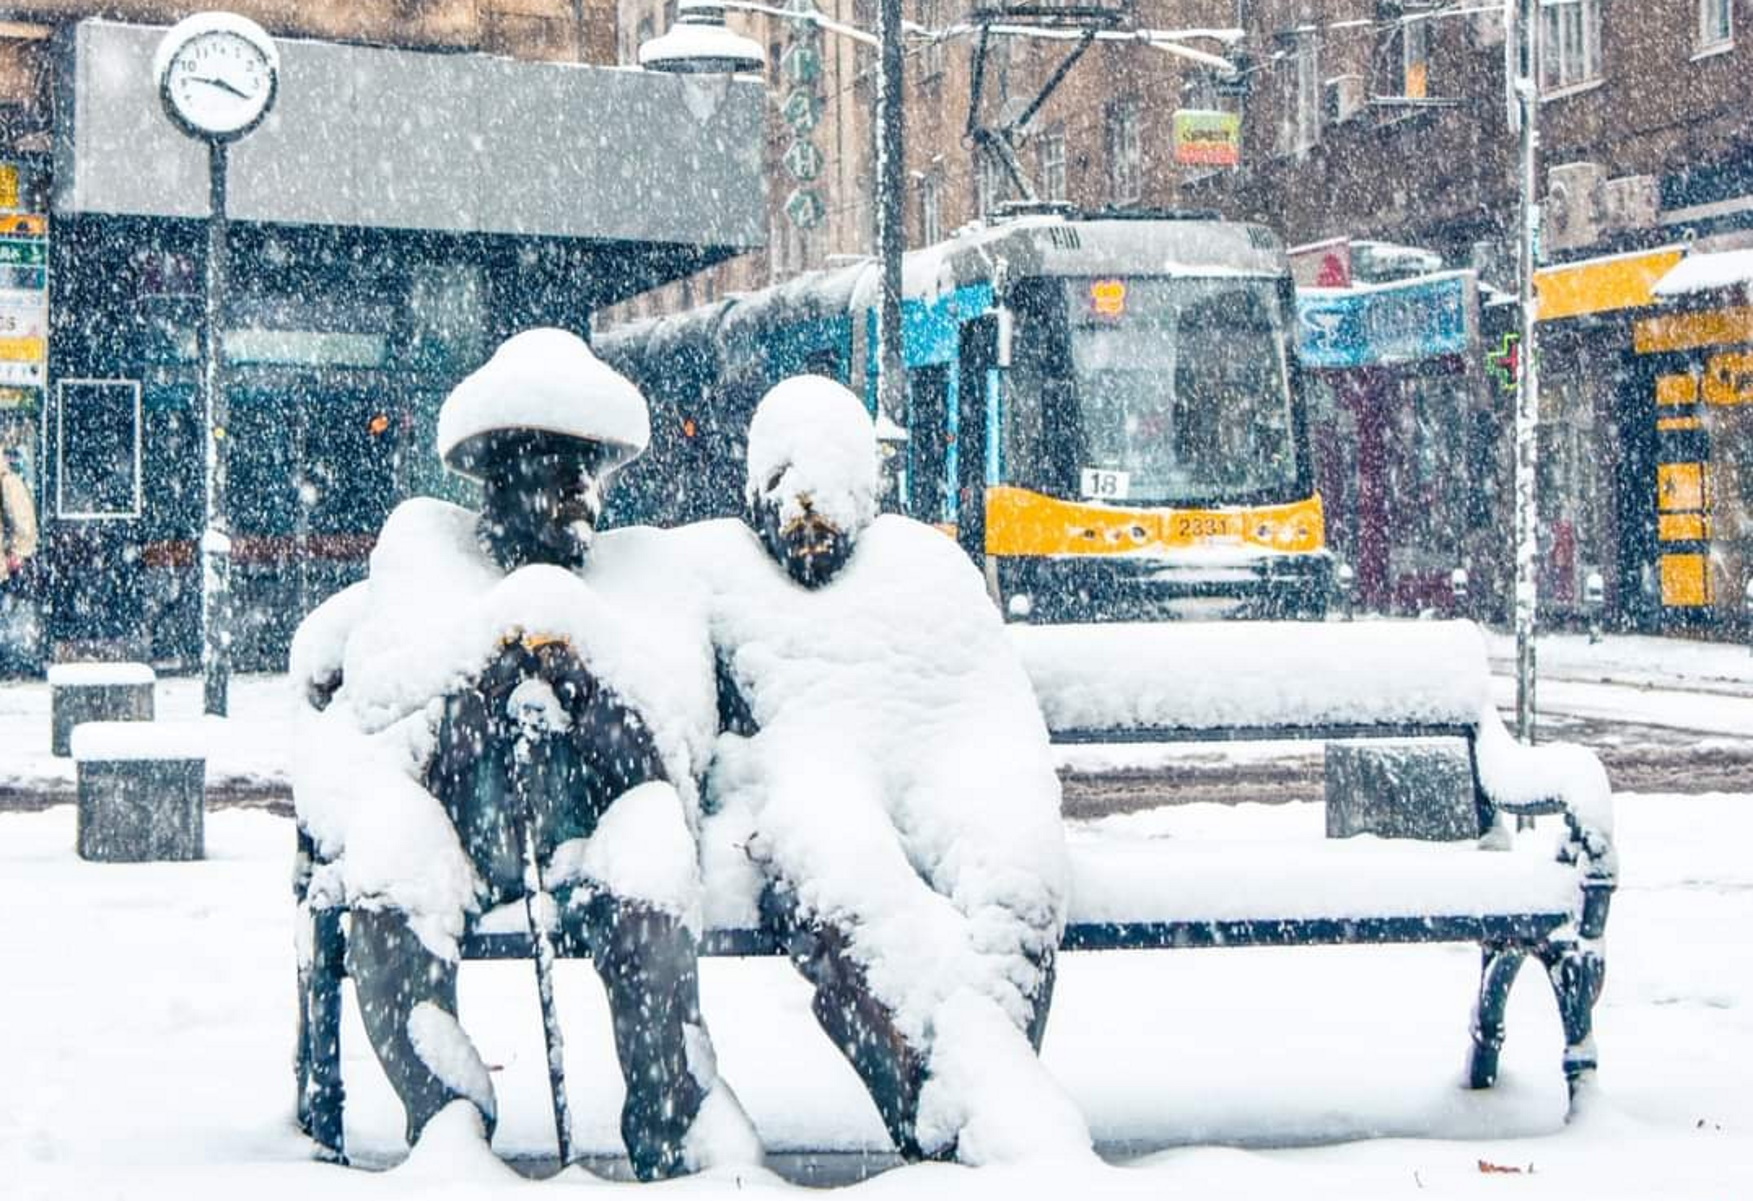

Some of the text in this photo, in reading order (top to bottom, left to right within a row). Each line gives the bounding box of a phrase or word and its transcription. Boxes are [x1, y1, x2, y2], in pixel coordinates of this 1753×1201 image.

[181, 60, 197, 72] 10
[1091, 472, 1117, 495] 18
[1179, 519, 1227, 537] 2331
